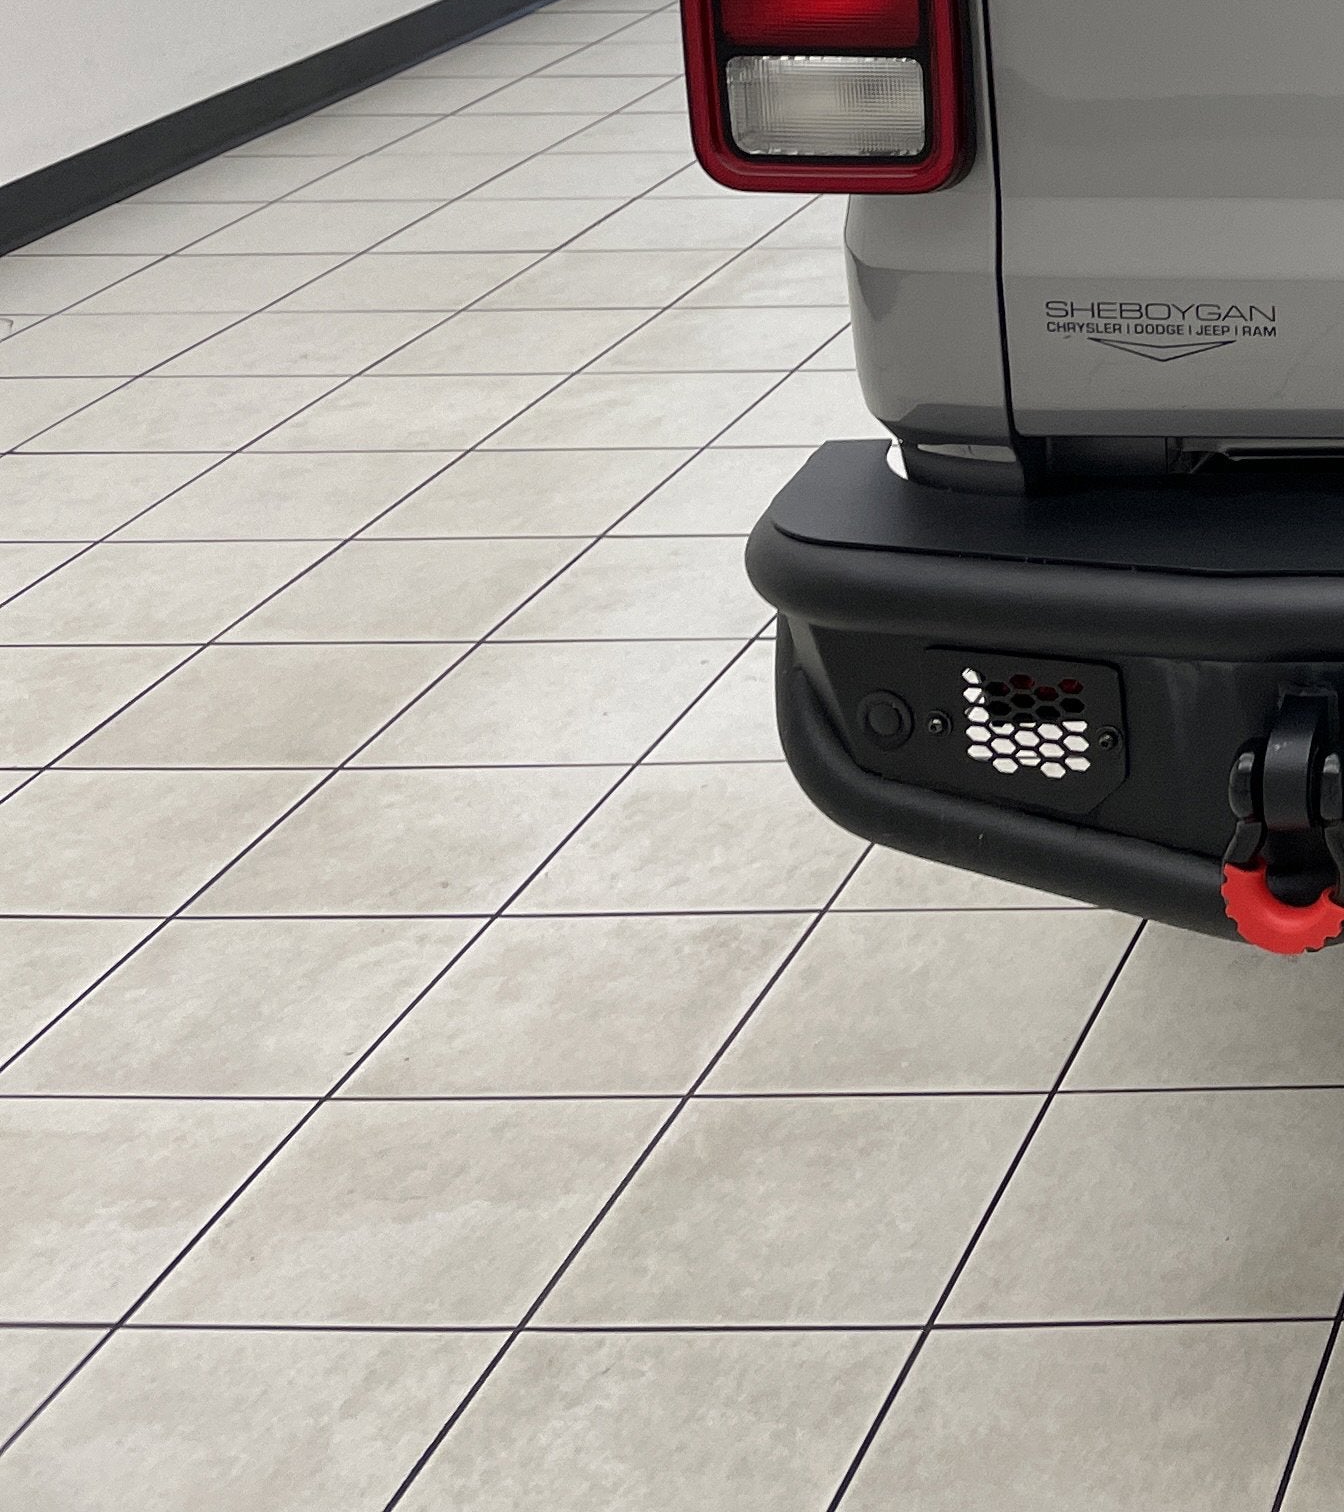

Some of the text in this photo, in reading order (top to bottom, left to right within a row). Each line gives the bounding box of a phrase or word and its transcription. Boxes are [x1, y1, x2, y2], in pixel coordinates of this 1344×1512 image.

[1045, 300, 1277, 322] SHEBOYGAN
[1046, 321, 1277, 338] CHRYSLER DODGE JEEP RAM
